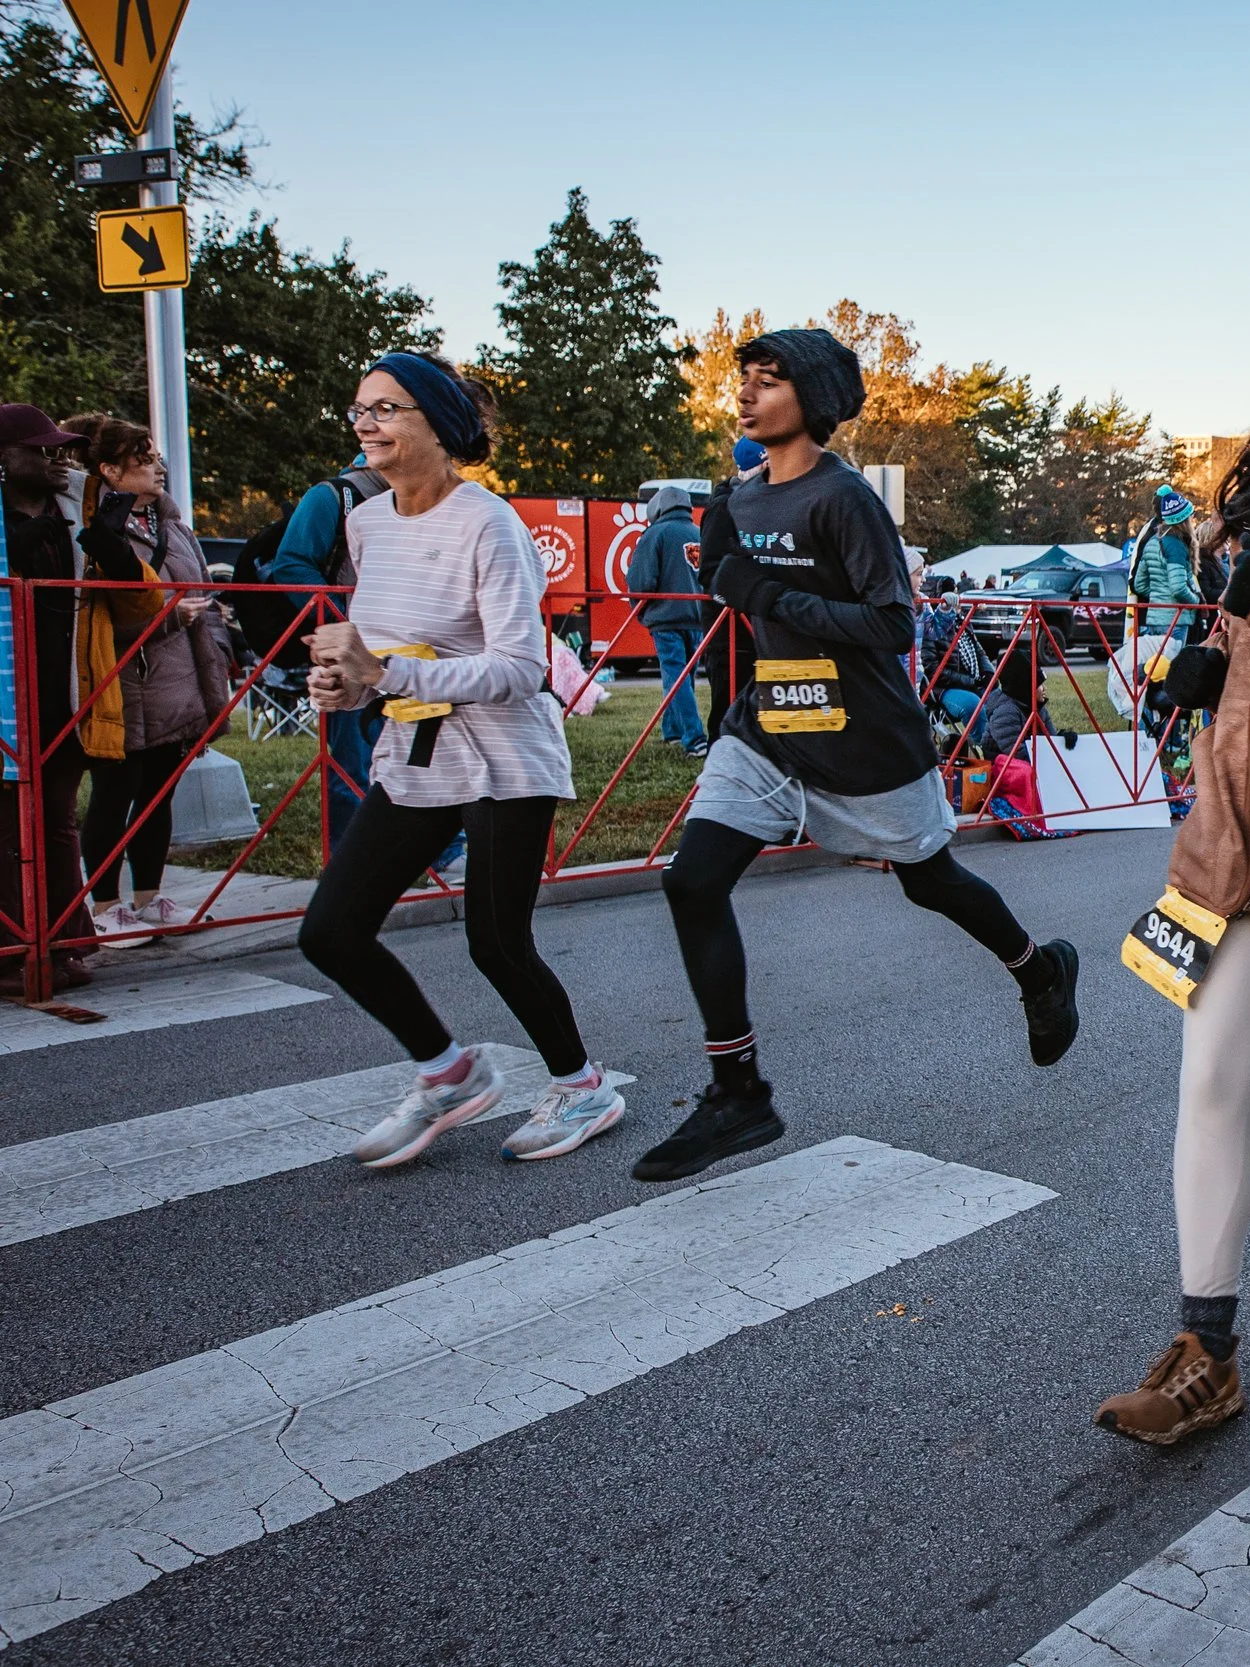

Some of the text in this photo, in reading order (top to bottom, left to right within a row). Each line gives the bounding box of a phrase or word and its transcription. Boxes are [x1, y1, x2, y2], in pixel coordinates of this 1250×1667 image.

[540, 524, 552, 533] THE
[771, 683, 829, 706] 9408
[1143, 912, 1196, 967] 9644
